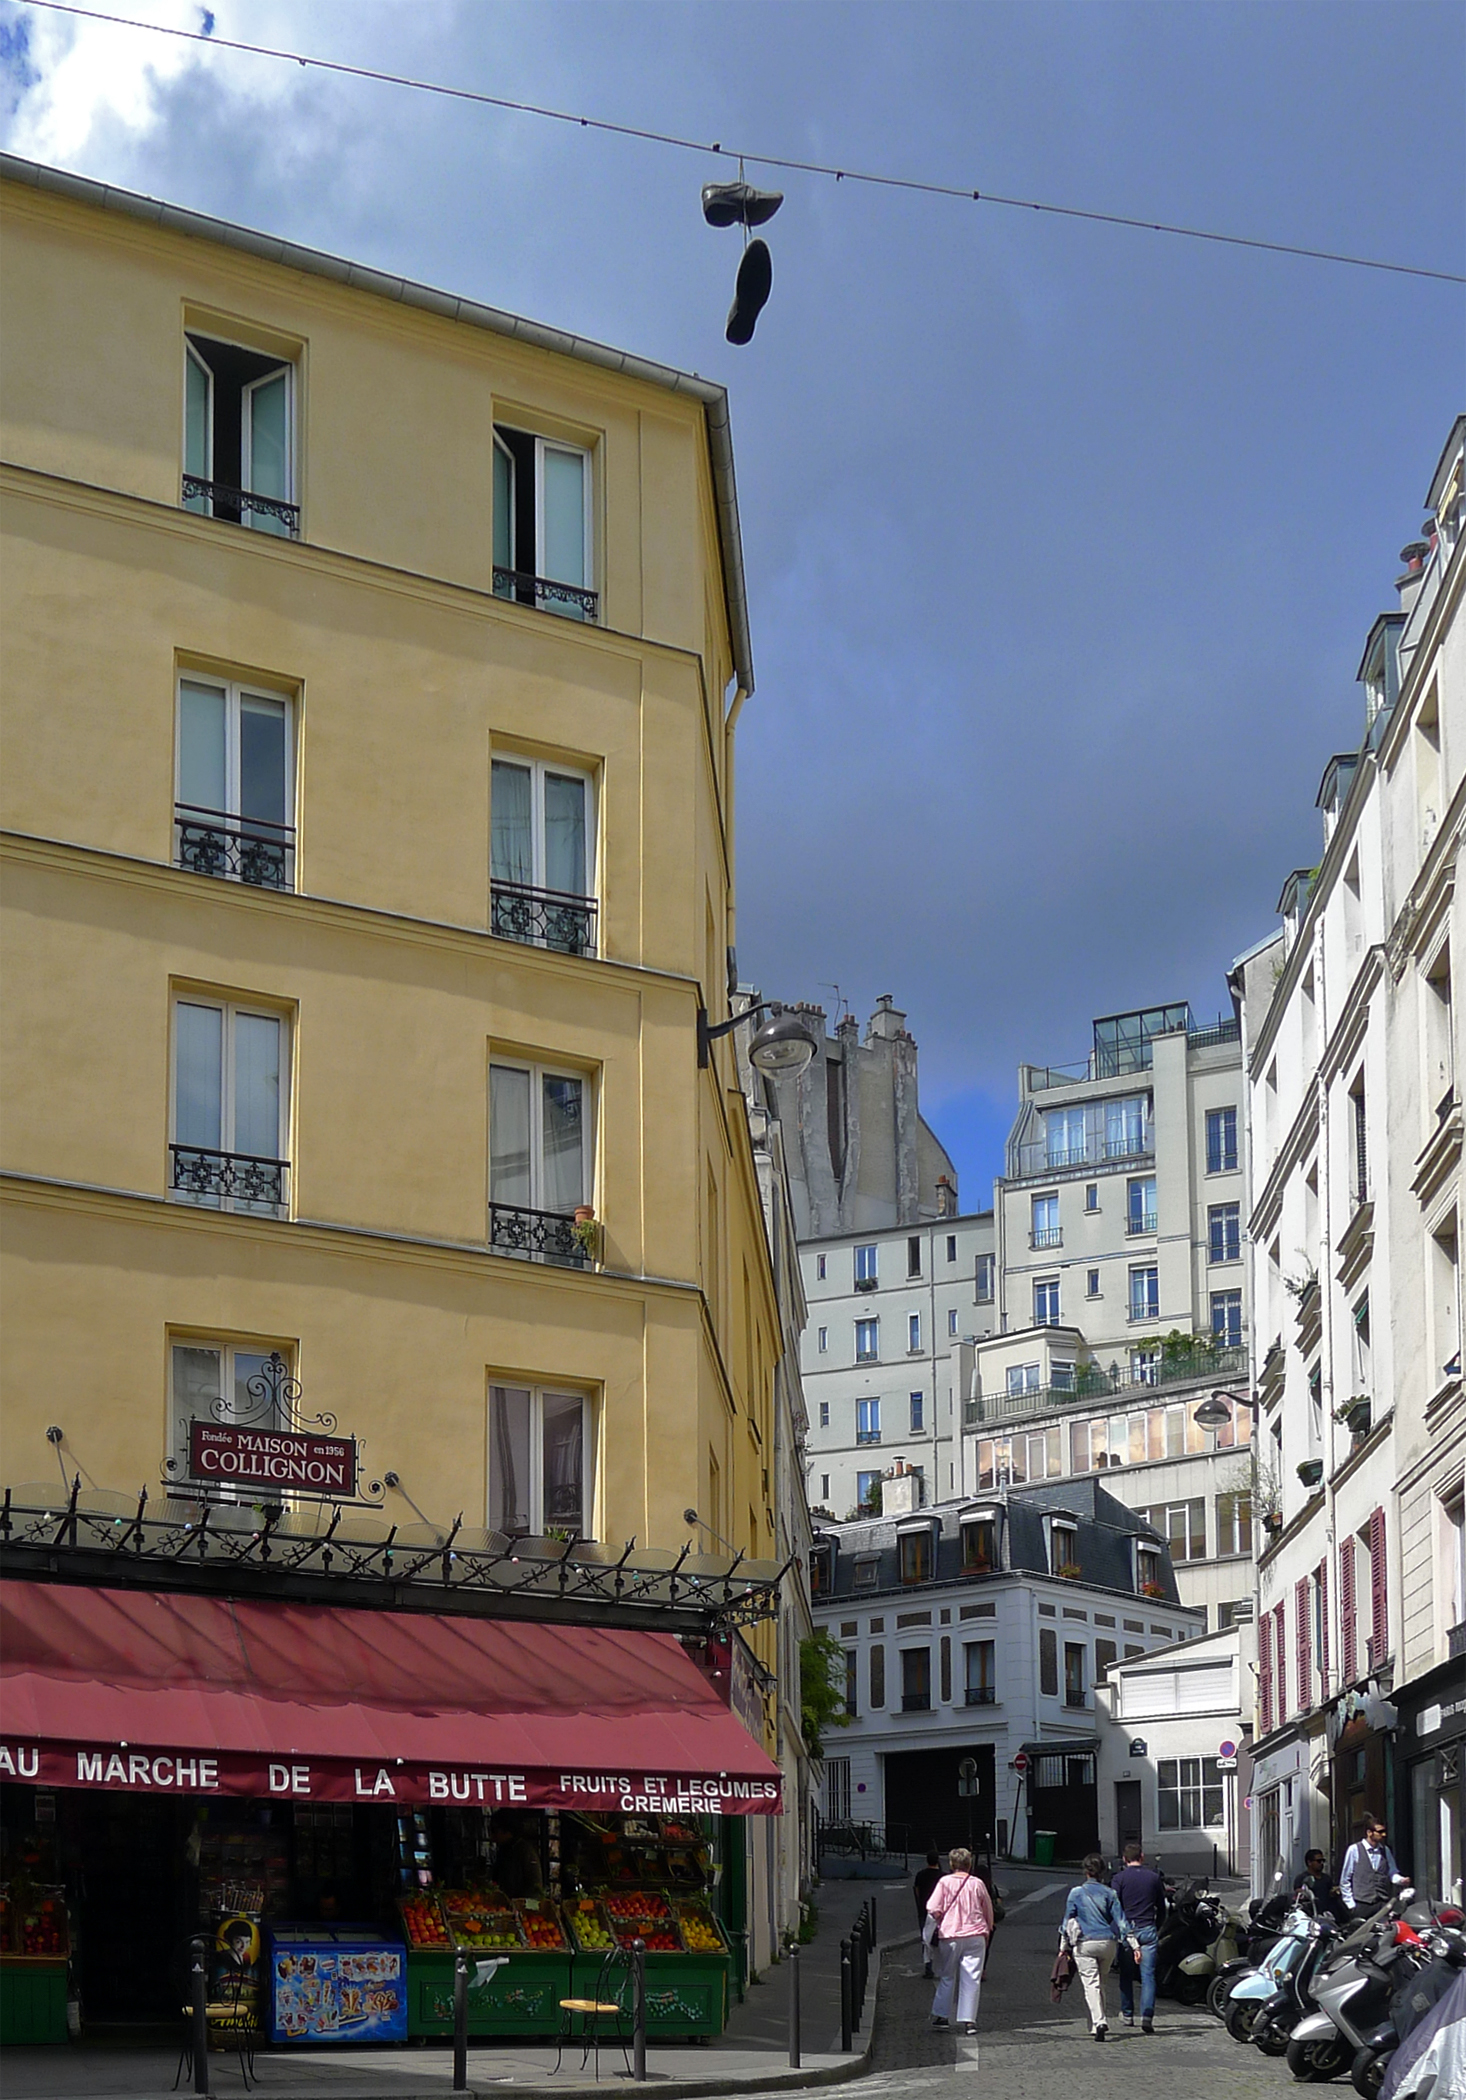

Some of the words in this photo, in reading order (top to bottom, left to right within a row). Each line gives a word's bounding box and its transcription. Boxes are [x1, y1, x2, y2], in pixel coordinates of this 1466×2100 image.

[201, 1430, 233, 1444] Fondée
[237, 1434, 308, 1458] MAISON
[313, 1445, 325, 1456] en
[201, 1449, 345, 1485] COLLIGNON
[0, 1746, 39, 1777] AU
[77, 1752, 219, 1788] MARCHE
[269, 1764, 311, 1793] DE
[354, 1768, 396, 1795] LA
[429, 1772, 527, 1801] BUTTE
[560, 1775, 632, 1794] FRUITS
[643, 1776, 668, 1794] ET
[676, 1778, 777, 1799] LEGUMES
[620, 1794, 723, 1814] CREMERIE
